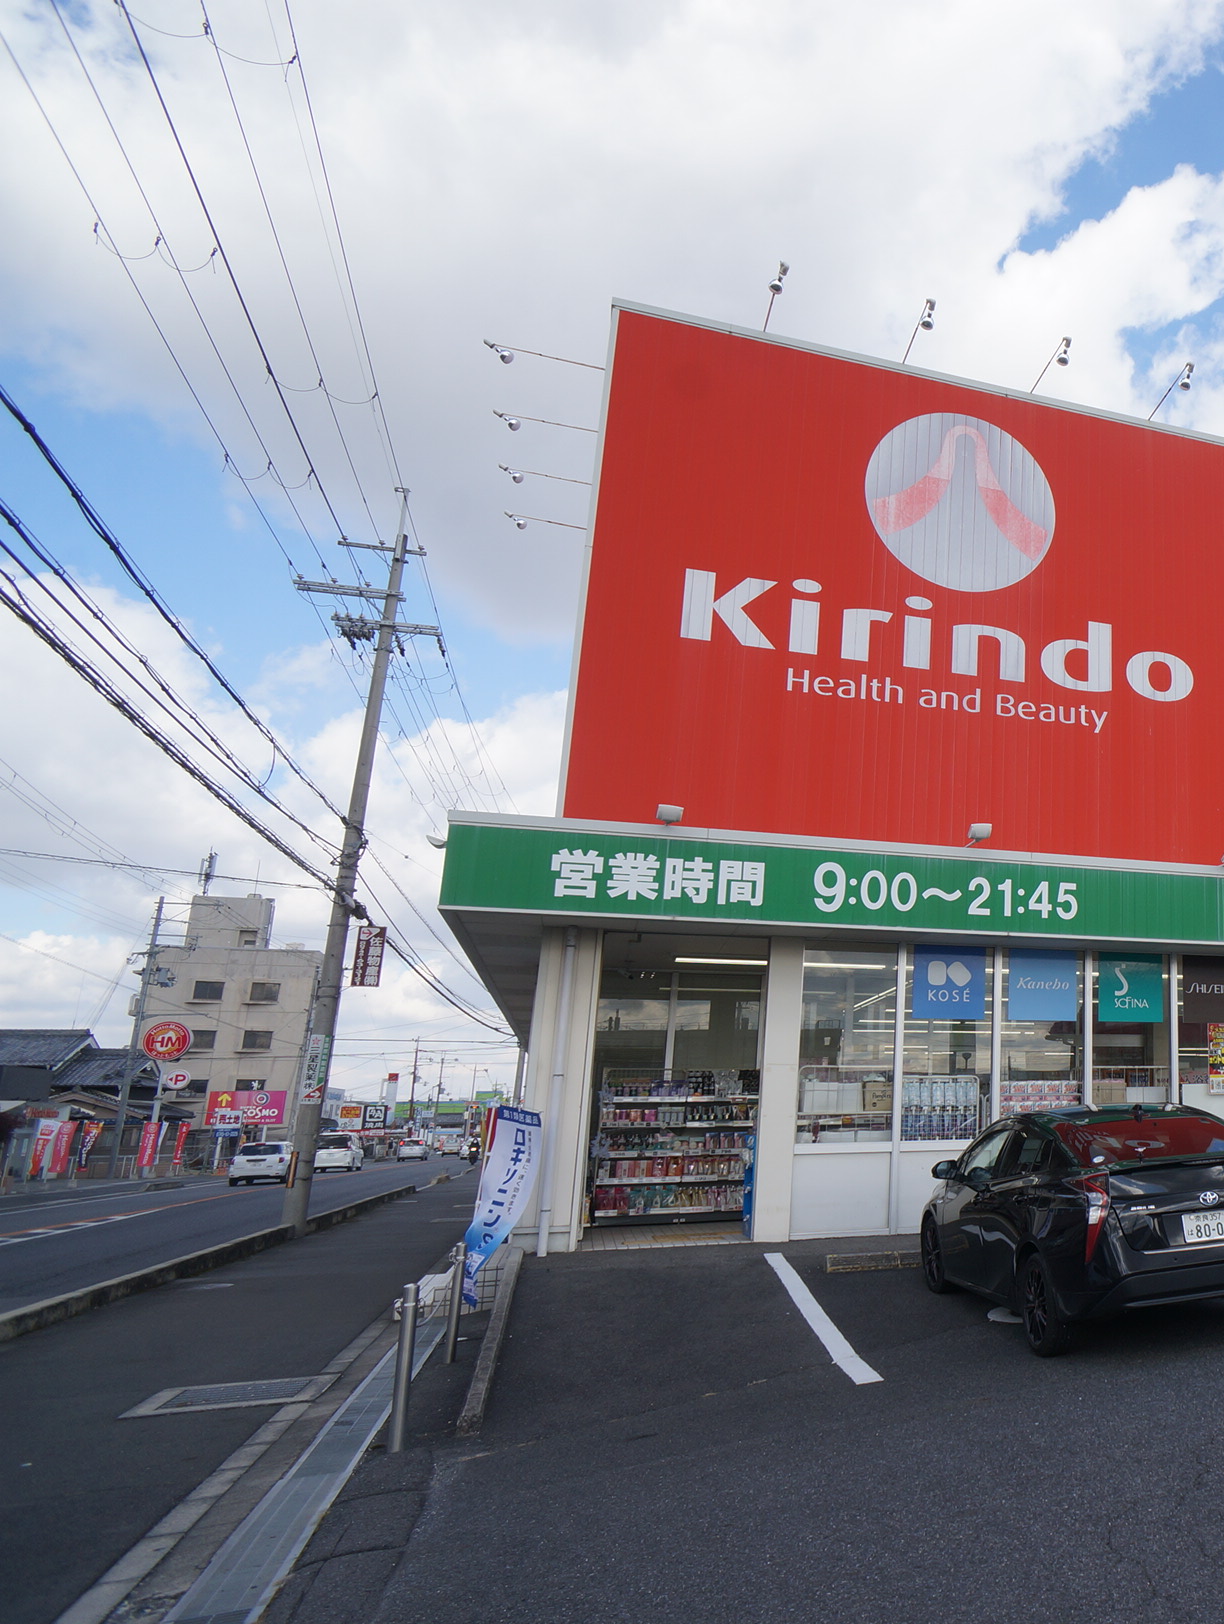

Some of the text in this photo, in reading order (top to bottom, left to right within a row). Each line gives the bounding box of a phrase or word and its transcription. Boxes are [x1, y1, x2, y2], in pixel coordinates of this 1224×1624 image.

[680, 568, 1194, 702] Kirindo
[786, 668, 1108, 734] Health and Beauty
[550, 848, 765, 906] 営業時間
[1016, 977, 1070, 991] Kanebo
[927, 988, 971, 1003] KOSÉ
[1113, 997, 1149, 1010] SOFINA
[150, 1036, 182, 1048] HM
[174, 1074, 187, 1085] P
